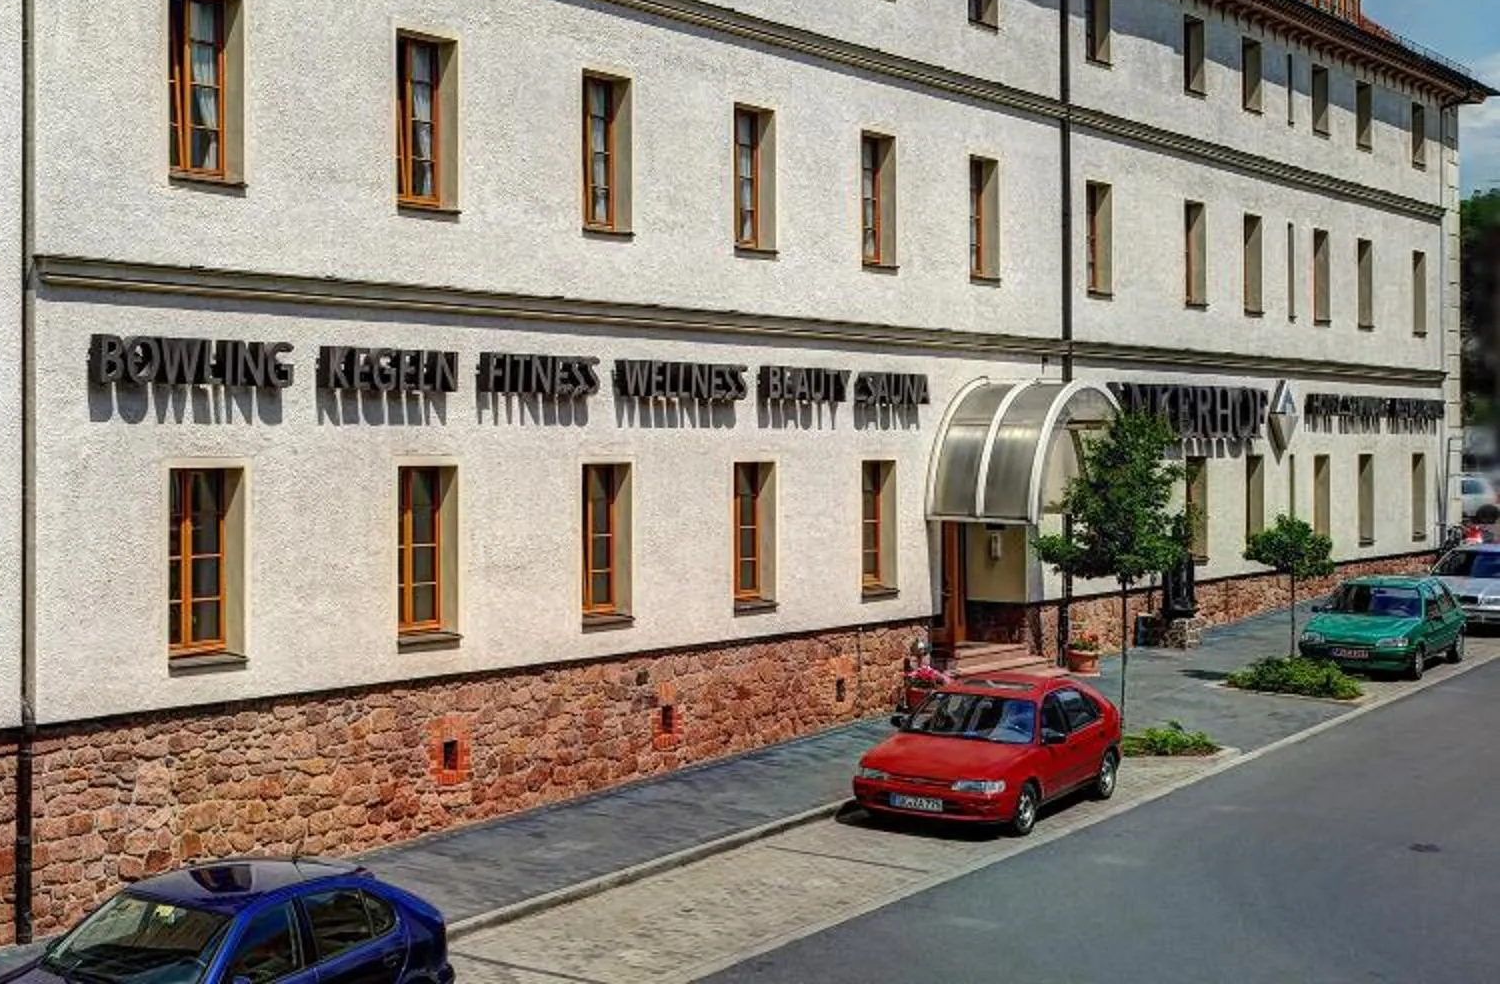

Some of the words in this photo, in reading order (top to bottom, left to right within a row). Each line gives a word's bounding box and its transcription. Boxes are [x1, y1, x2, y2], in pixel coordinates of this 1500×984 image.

[90, 334, 295, 389] BOWLING
[322, 346, 459, 392] KEGELN
[481, 352, 600, 396] FITNESS
[615, 359, 748, 400] WELLNESS
[762, 365, 852, 404] BEAUTY
[857, 371, 930, 405] SAUNA
[1106, 382, 1268, 439] NKERHOF
